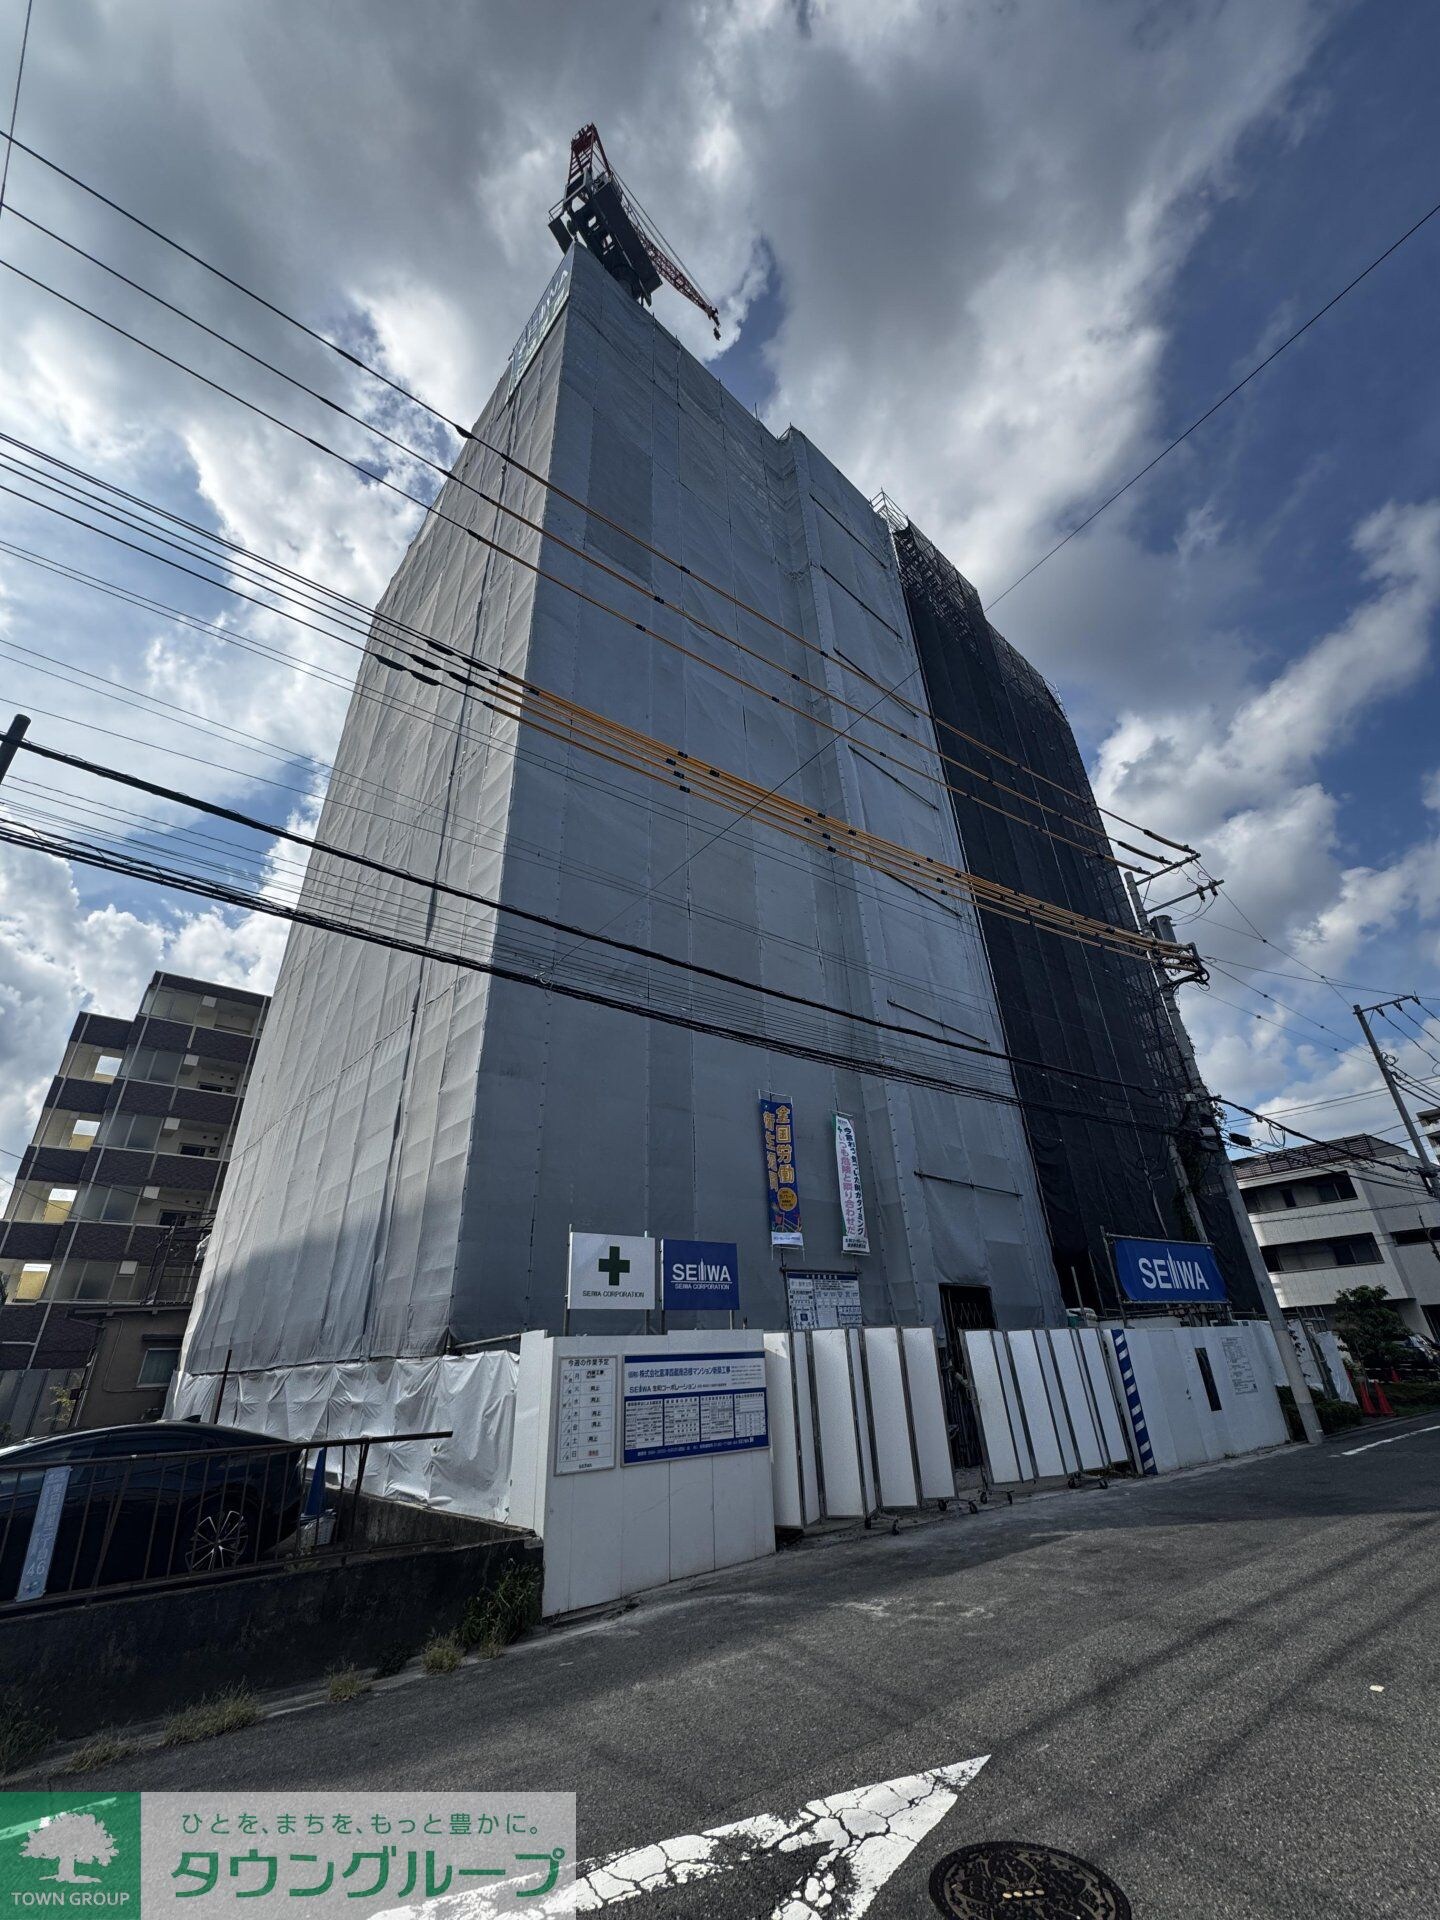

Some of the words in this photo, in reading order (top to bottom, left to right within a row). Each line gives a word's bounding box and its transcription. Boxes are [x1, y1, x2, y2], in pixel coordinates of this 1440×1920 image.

[775, 1104, 795, 1184] 全国労働
[672, 1258, 731, 1282] SEIWA
[1138, 1248, 1210, 1290] SEIWA
[602, 1290, 645, 1298] CORPORATION
[692, 1283, 730, 1291] CORPORATION
